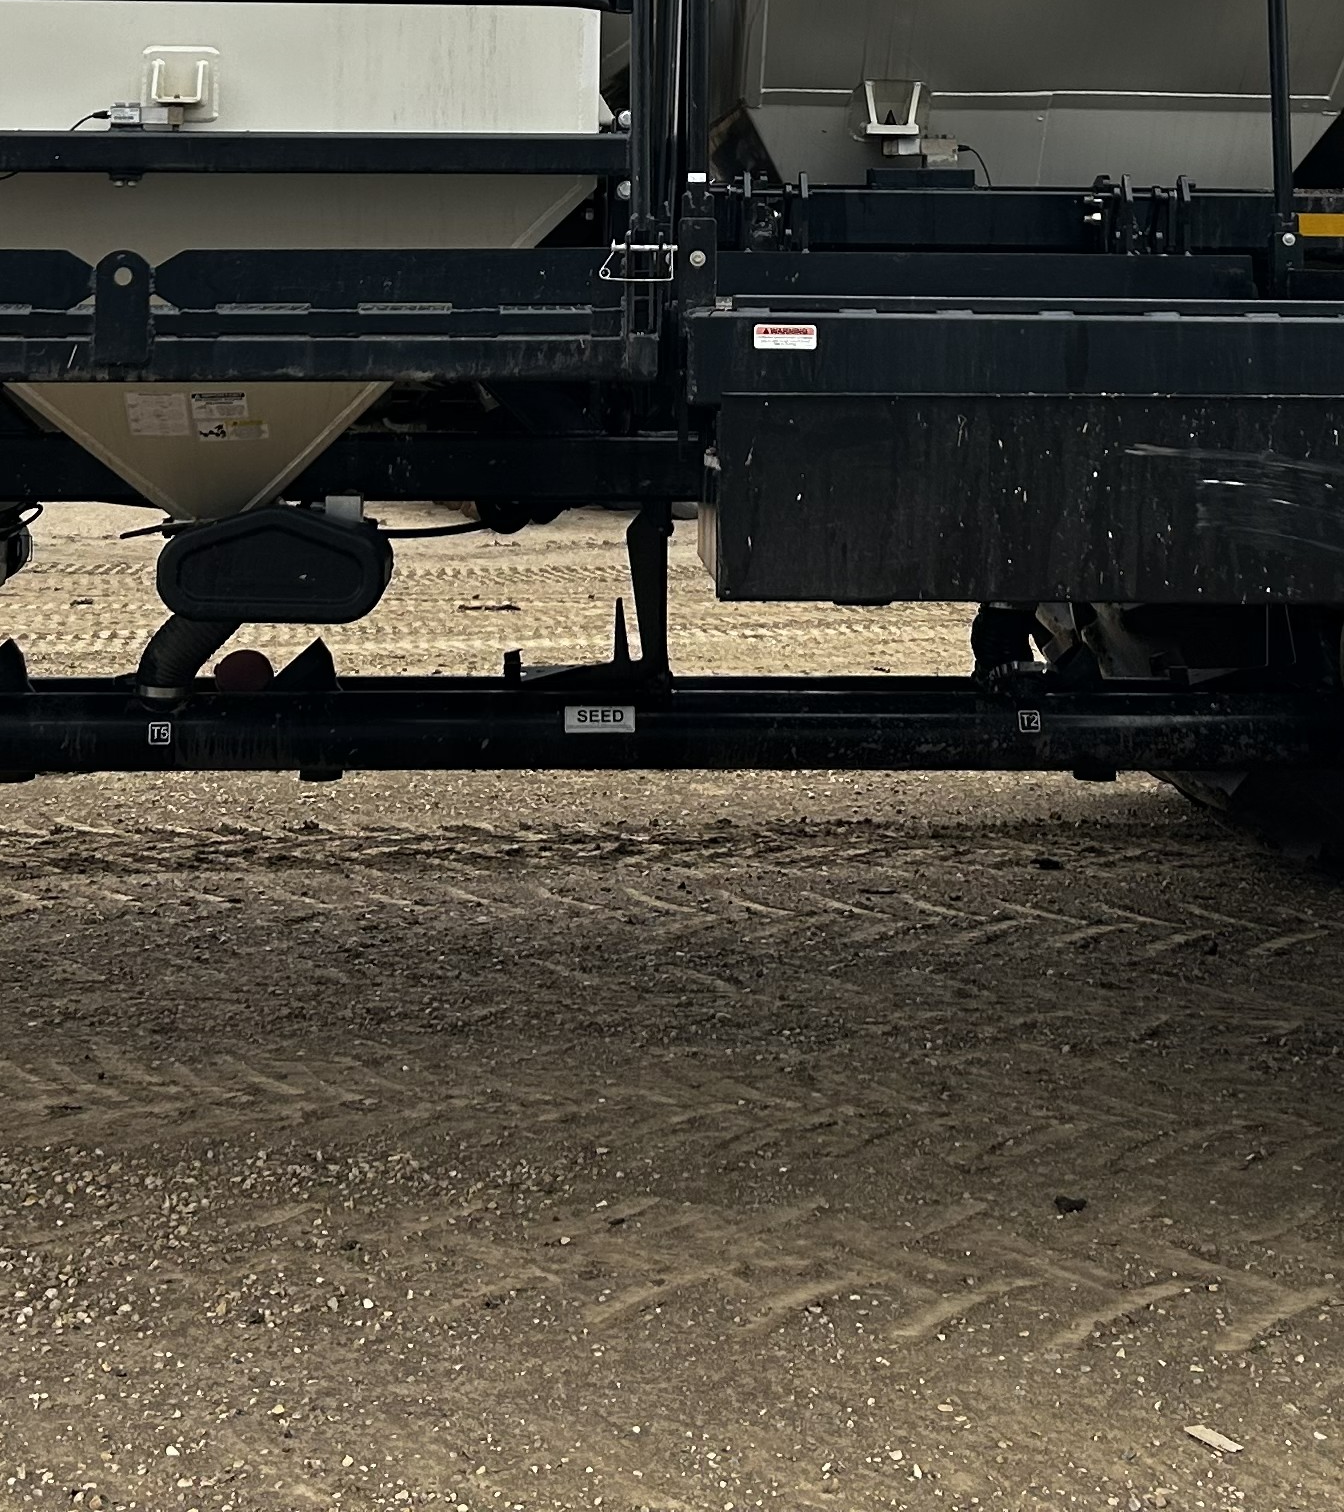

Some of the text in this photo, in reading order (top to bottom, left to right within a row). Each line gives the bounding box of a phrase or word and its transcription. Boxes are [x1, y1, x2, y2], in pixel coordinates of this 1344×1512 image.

[577, 709, 624, 723] SEED
[1021, 714, 1039, 727] T2
[151, 726, 168, 740] T5
